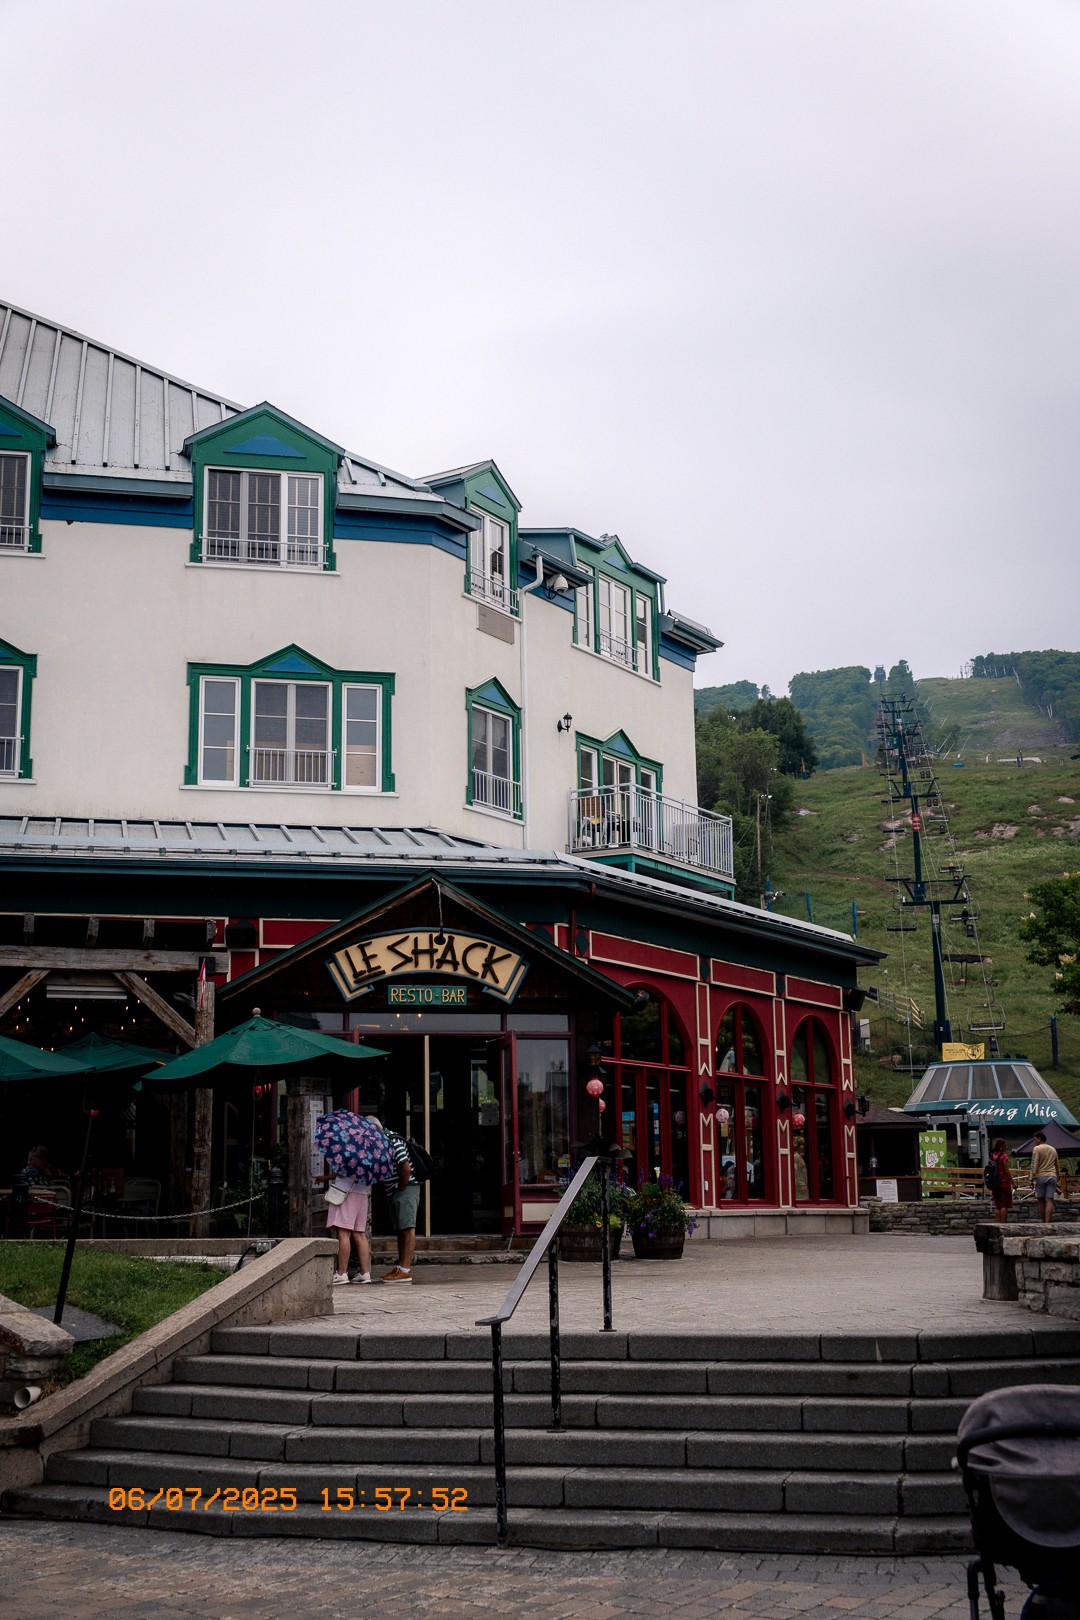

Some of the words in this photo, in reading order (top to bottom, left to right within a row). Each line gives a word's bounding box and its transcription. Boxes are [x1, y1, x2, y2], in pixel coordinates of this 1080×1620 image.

[345, 941, 386, 983] LE
[387, 933, 512, 983] SHACK
[1024, 1103, 1058, 1118] Mile
